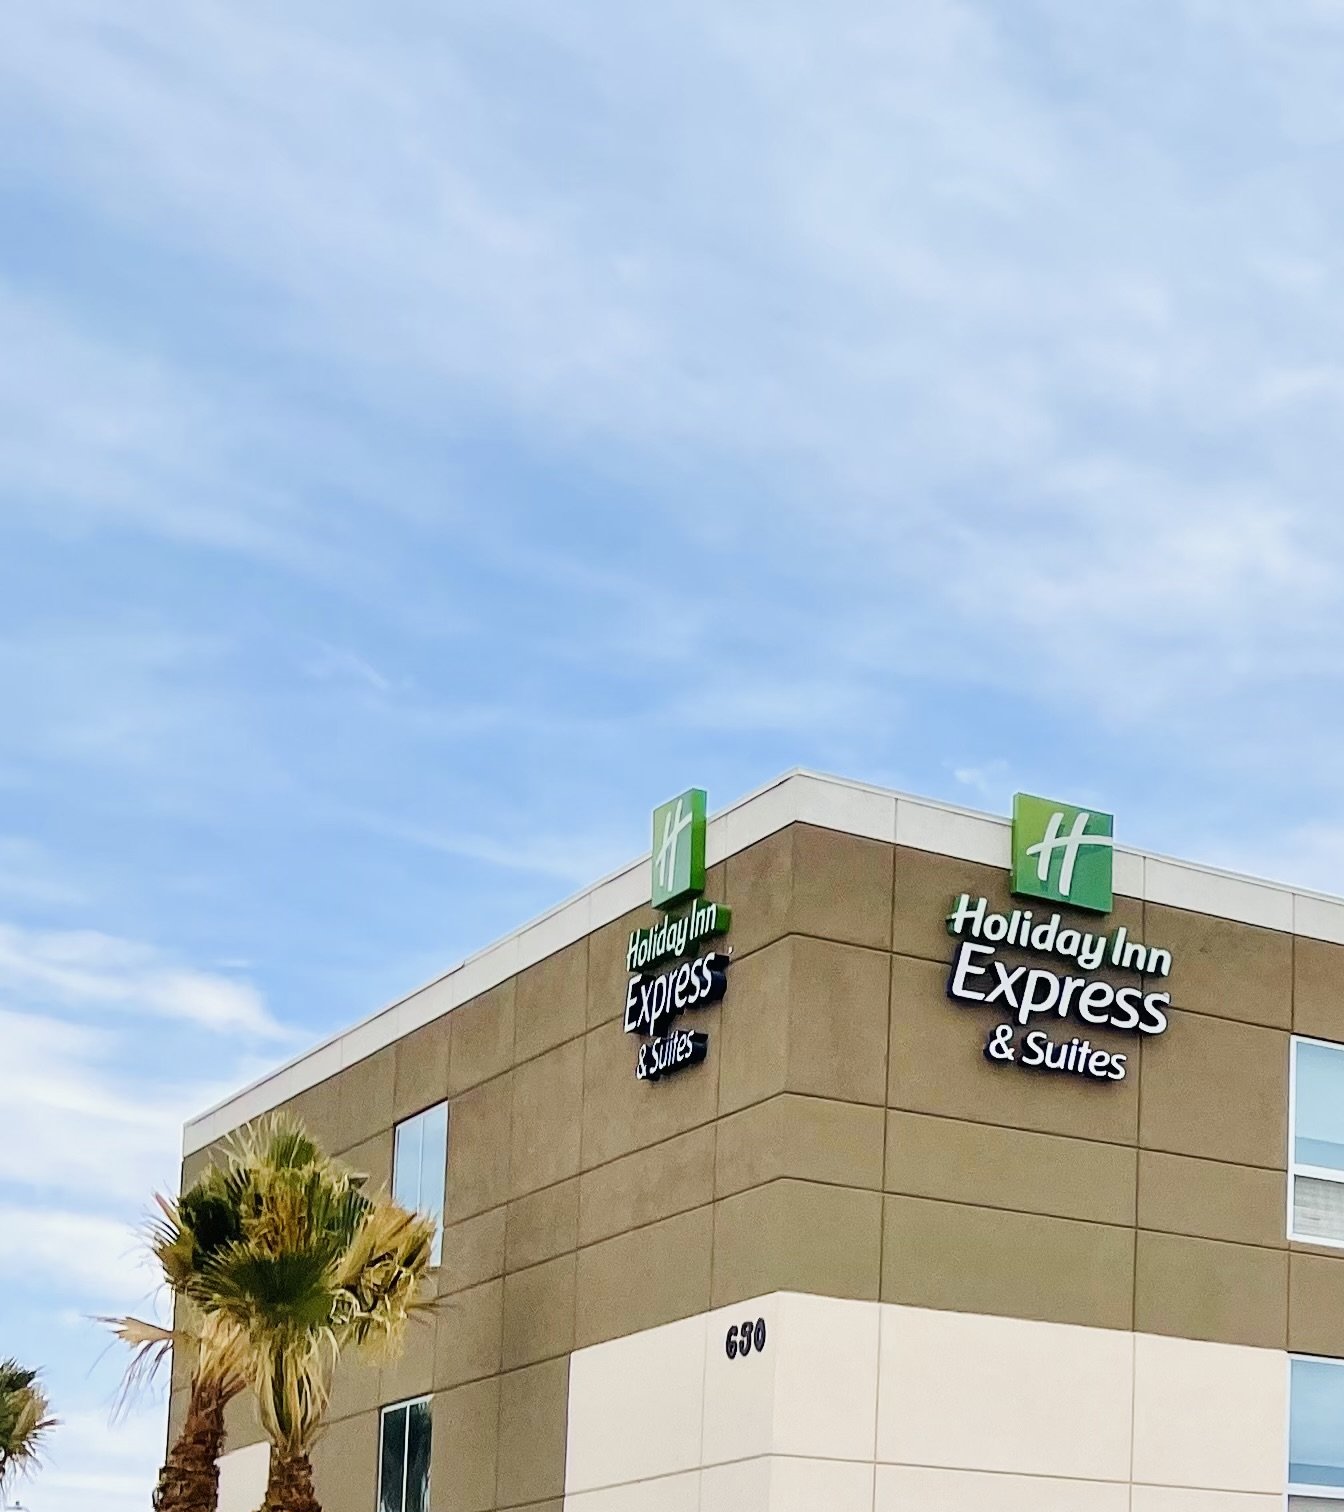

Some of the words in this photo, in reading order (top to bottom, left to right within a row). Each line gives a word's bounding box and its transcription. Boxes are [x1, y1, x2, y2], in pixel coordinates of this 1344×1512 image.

[626, 915, 690, 972] Holiday
[689, 898, 717, 941] Inn
[952, 893, 1107, 970] Holiday
[1111, 926, 1173, 977] Inn
[623, 952, 716, 1036] Express
[951, 940, 1172, 1035] Express
[636, 1044, 650, 1080] &
[649, 1029, 695, 1075] Suites
[988, 1023, 1016, 1062] &
[1022, 1030, 1128, 1081] Suites
